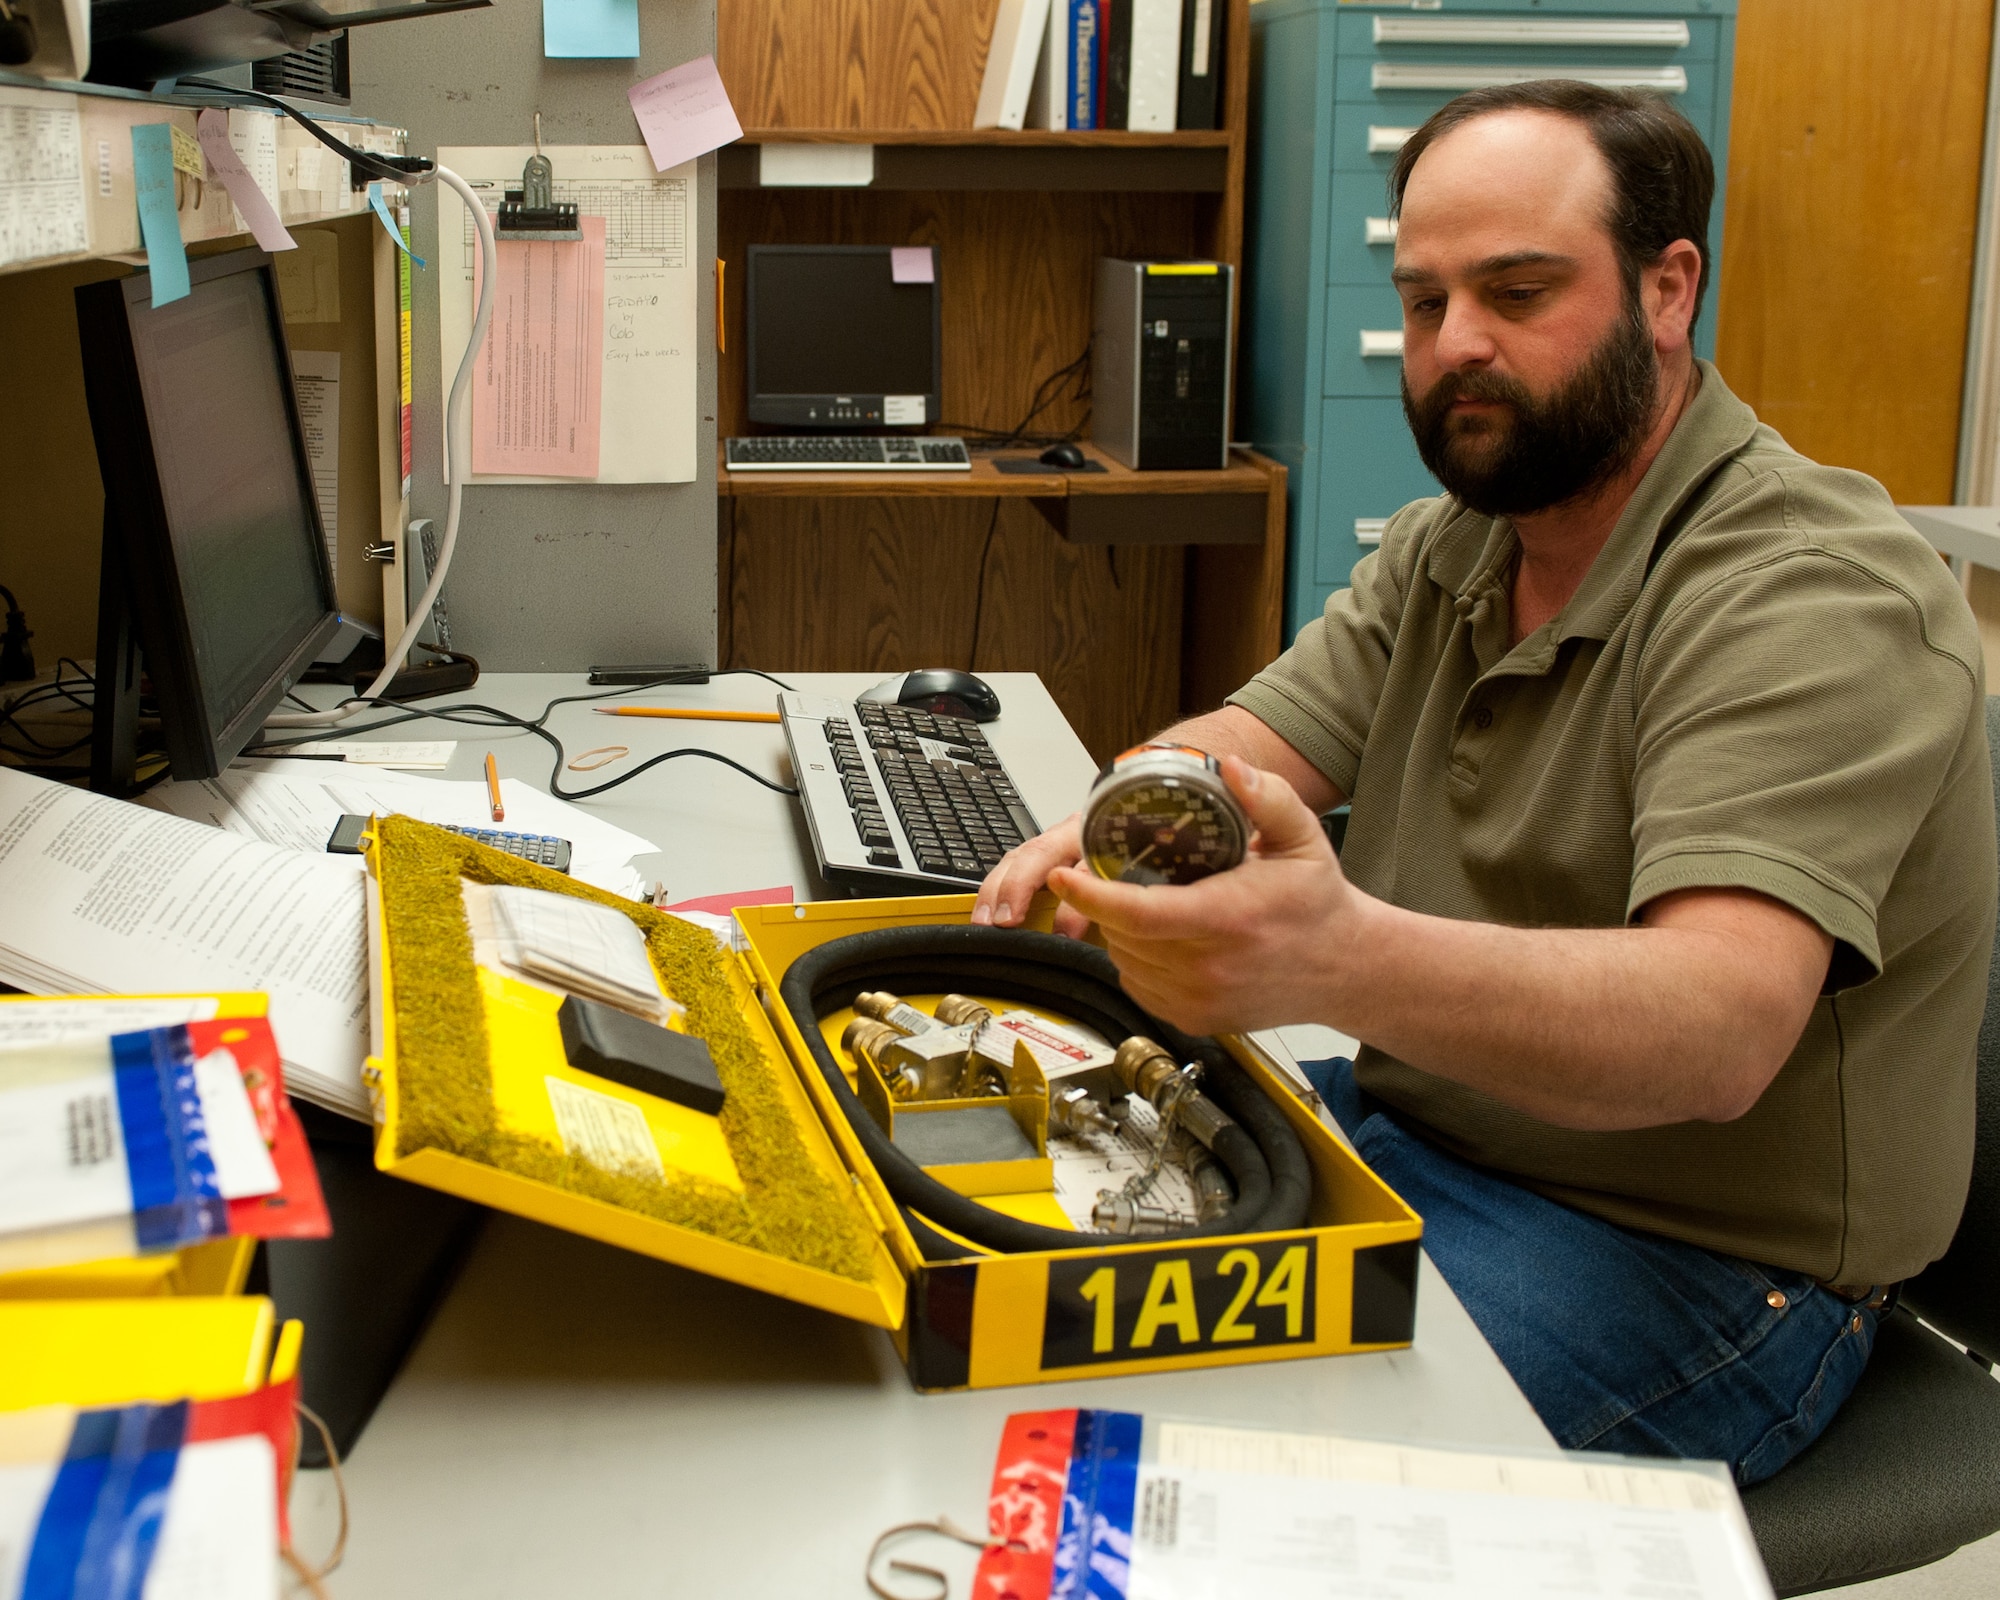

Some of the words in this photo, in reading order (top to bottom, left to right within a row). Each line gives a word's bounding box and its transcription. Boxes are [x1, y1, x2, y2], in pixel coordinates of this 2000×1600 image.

[622, 312, 634, 325] by
[606, 348, 629, 363] Every
[636, 347, 650, 358] two
[655, 348, 680, 357] weeks
[1079, 1246, 1308, 1353] 1A24
